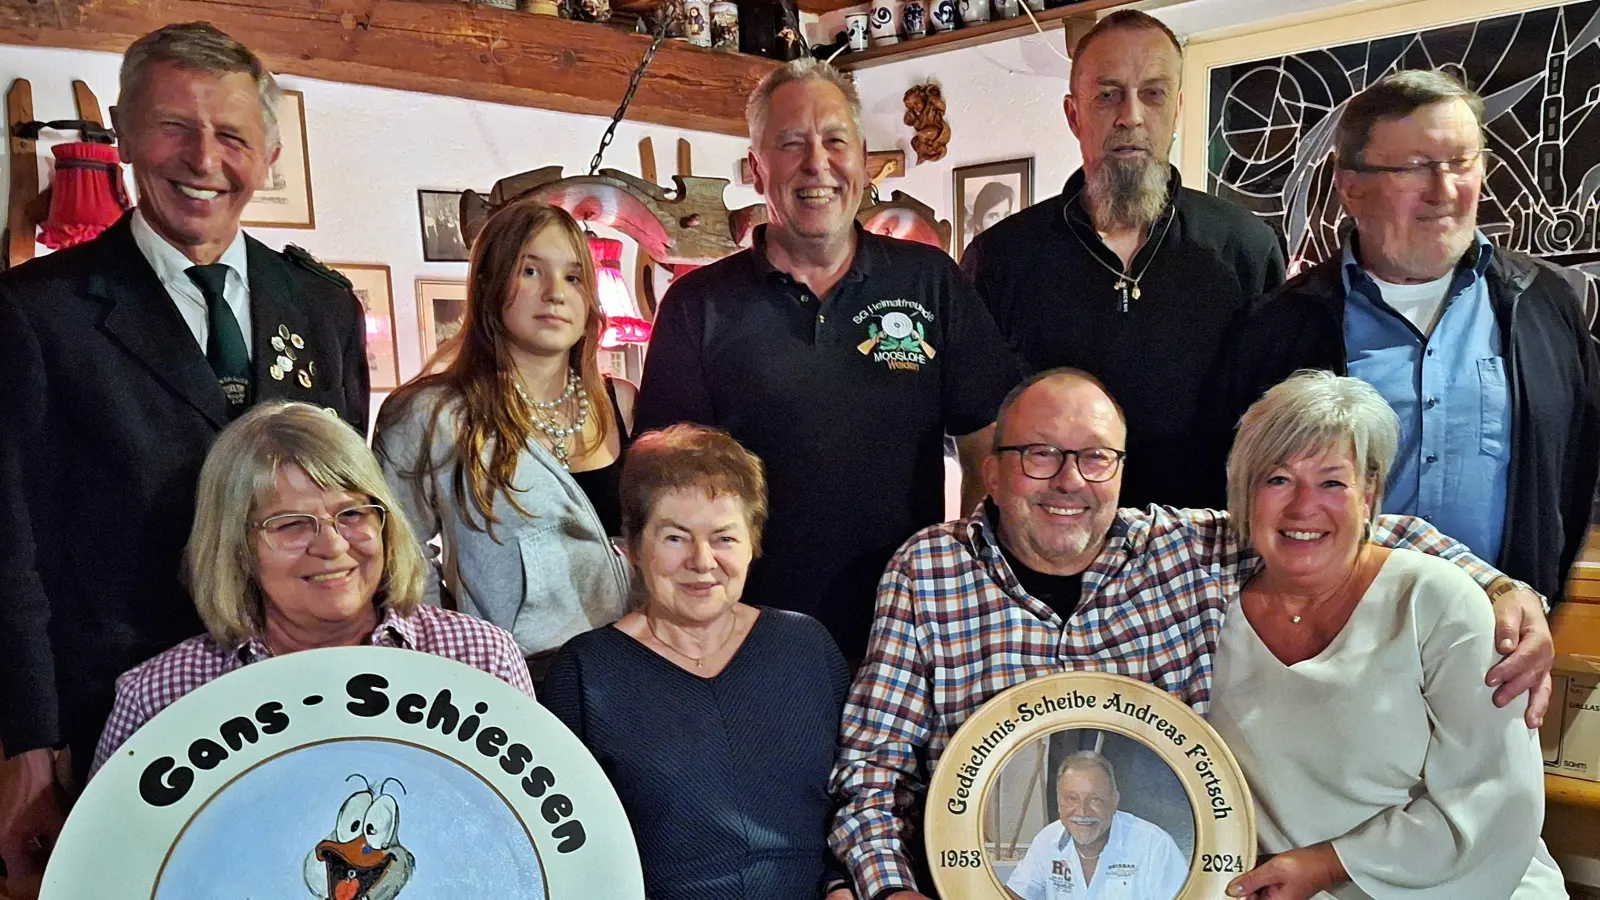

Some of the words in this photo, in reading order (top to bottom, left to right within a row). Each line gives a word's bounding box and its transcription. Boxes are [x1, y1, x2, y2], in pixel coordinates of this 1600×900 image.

[873, 351, 926, 364] MOOSLOHE
[886, 360, 920, 372] Weiden
[138, 700, 291, 807] Gans
[345, 673, 588, 854] Schiessen
[947, 690, 1097, 816] Gedächtnis-Scheibe
[1102, 692, 1188, 748] Andreas
[1184, 743, 1233, 821] Förtsch
[939, 849, 981, 868] 1953
[1201, 854, 1245, 873] 2024
